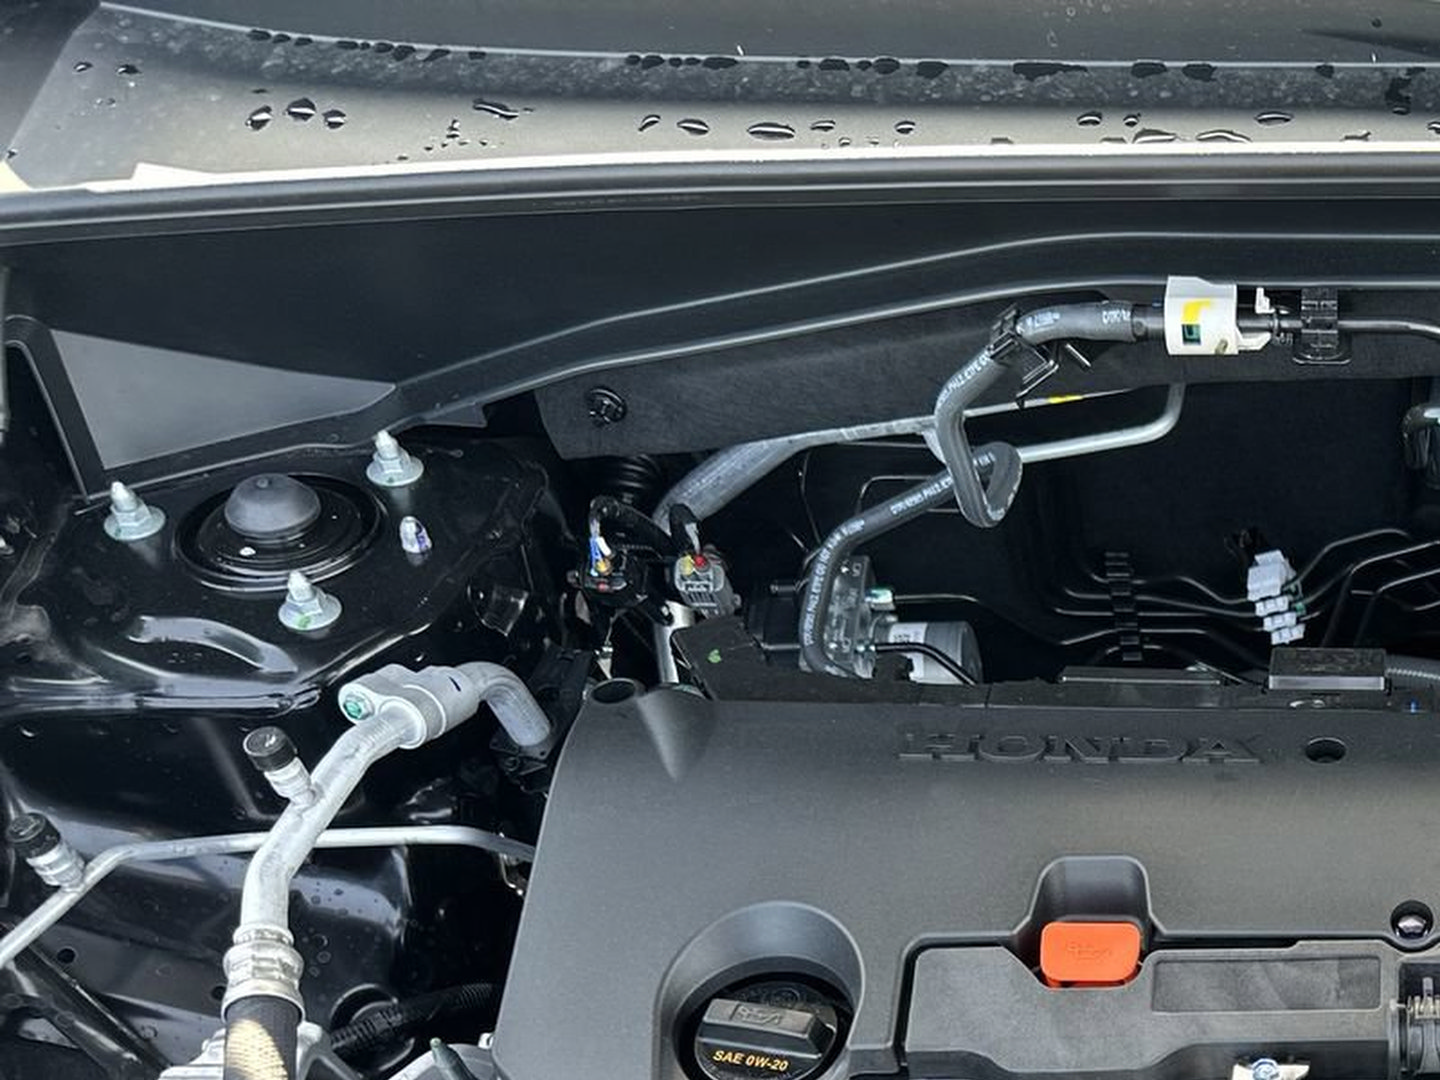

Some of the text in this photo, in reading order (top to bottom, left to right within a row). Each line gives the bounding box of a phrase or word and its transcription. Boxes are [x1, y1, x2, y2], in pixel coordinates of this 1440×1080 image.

[897, 732, 1264, 765] HONDA
[712, 1049, 789, 1073] SAE 0W-20
